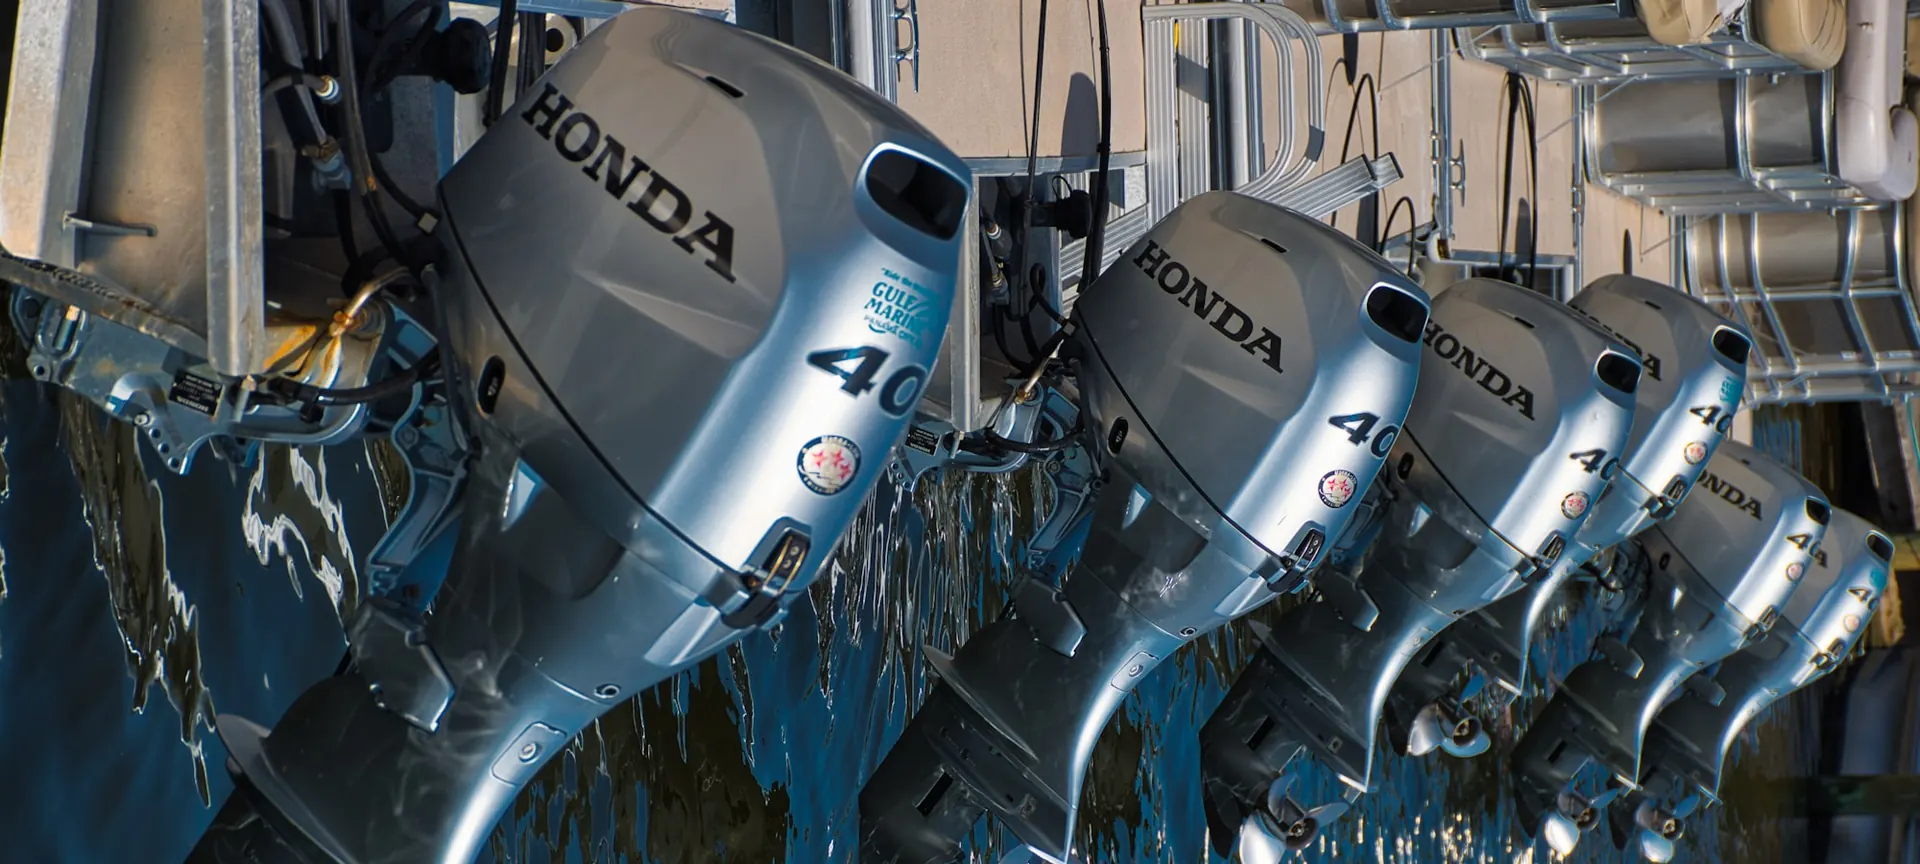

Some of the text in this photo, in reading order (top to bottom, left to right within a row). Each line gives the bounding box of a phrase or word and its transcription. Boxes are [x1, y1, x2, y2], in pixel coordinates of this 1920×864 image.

[521, 82, 737, 284] HONDA
[872, 281, 918, 310] GULF
[1133, 240, 1284, 374] HONDA
[807, 346, 928, 418] 40
[1328, 411, 1400, 458] 40
[1689, 405, 1733, 434] 40
[1569, 448, 1619, 480] 40
[1697, 469, 1763, 522] NDA
